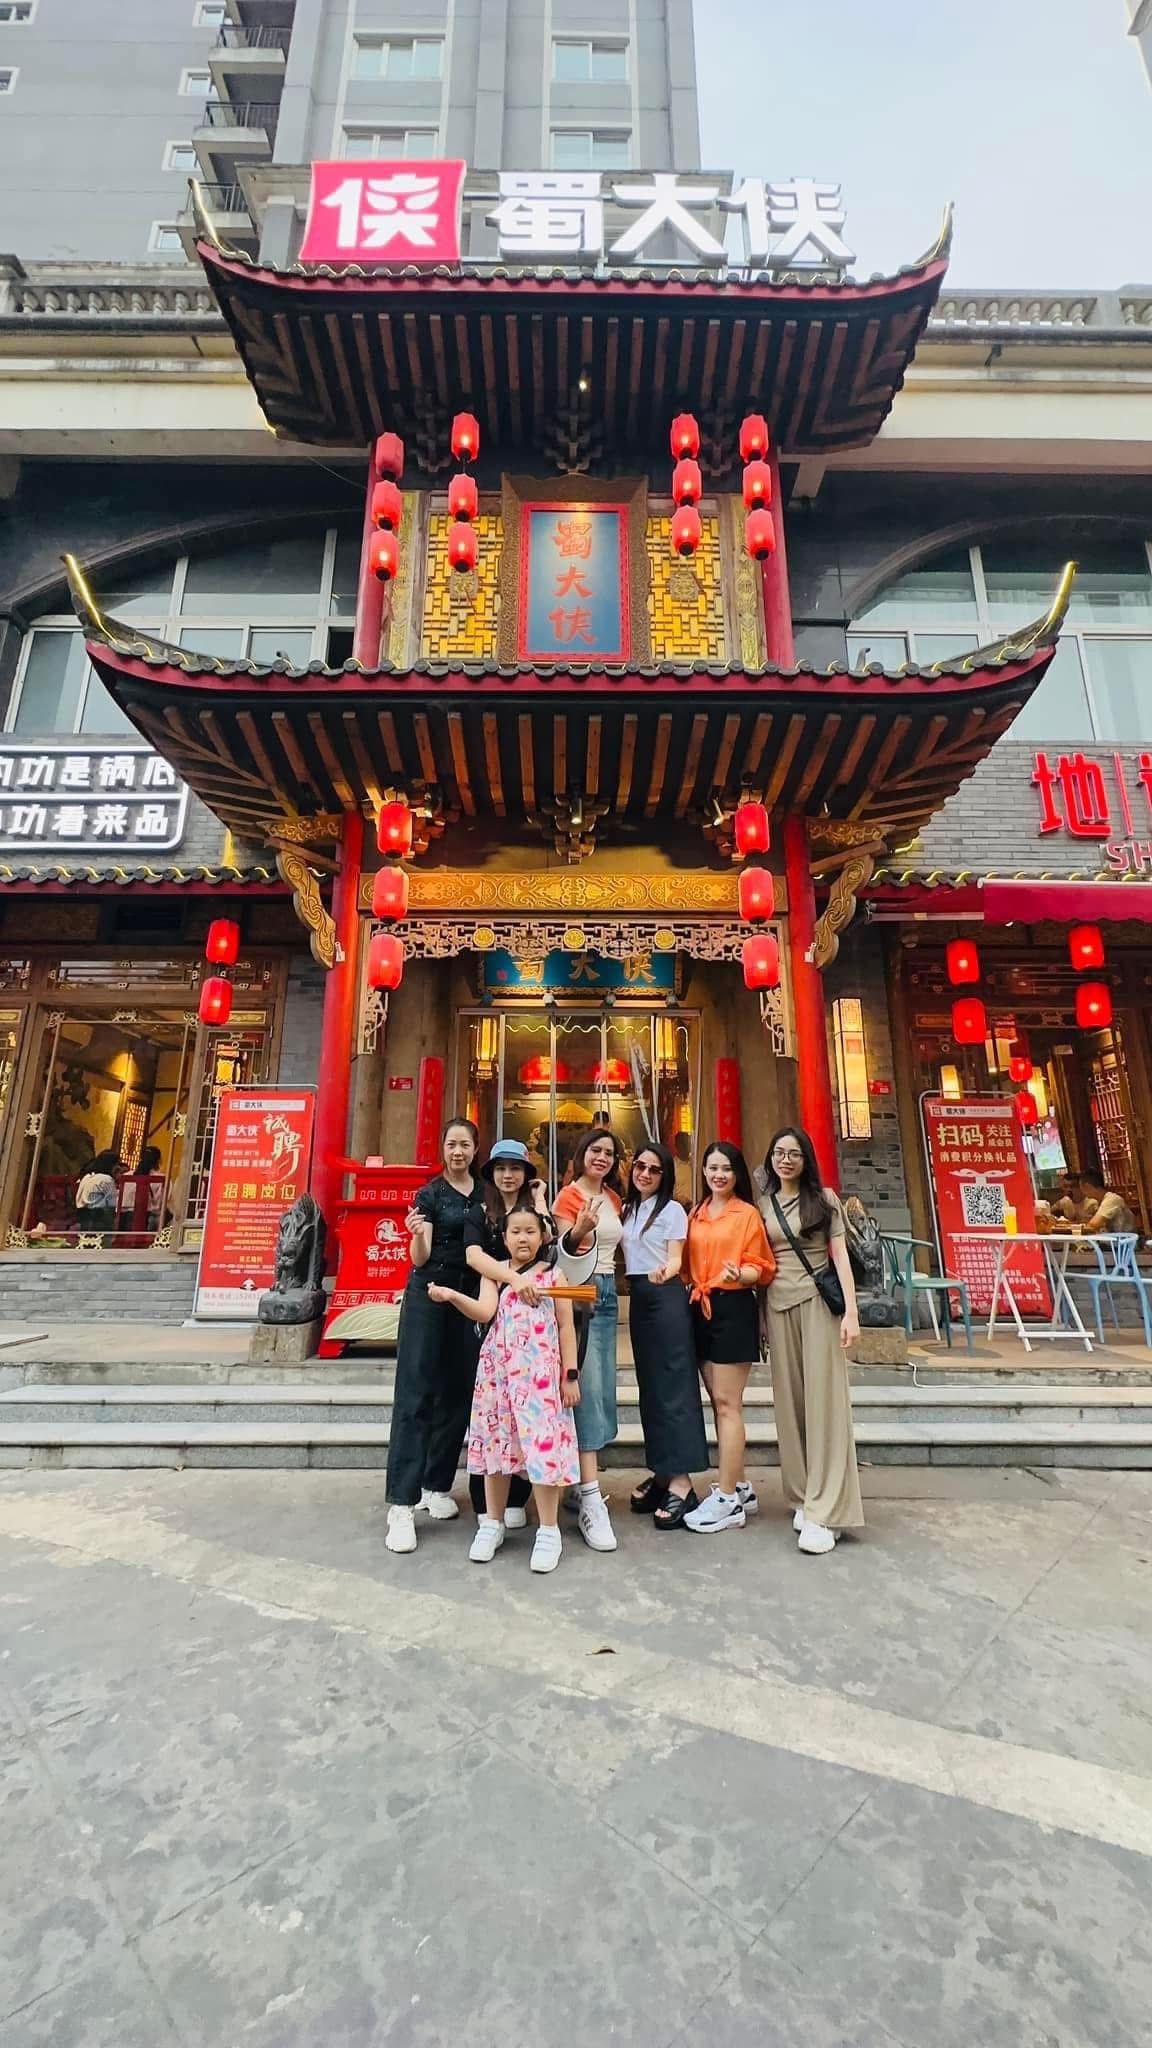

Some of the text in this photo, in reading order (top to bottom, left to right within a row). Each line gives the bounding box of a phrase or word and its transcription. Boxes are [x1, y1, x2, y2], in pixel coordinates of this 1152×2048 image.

[486, 172, 857, 265] 蜀大侠
[548, 519, 598, 645] 蜀大侠
[0, 804, 170, 837] 功看菜品
[937, 1123, 984, 1147] 扫码
[986, 1124, 1012, 1137] 关注
[940, 1151, 1017, 1163] 消费积分换礼品
[223, 1183, 296, 1200] 招聘岗位
[365, 1245, 408, 1262] 蜀大侠
